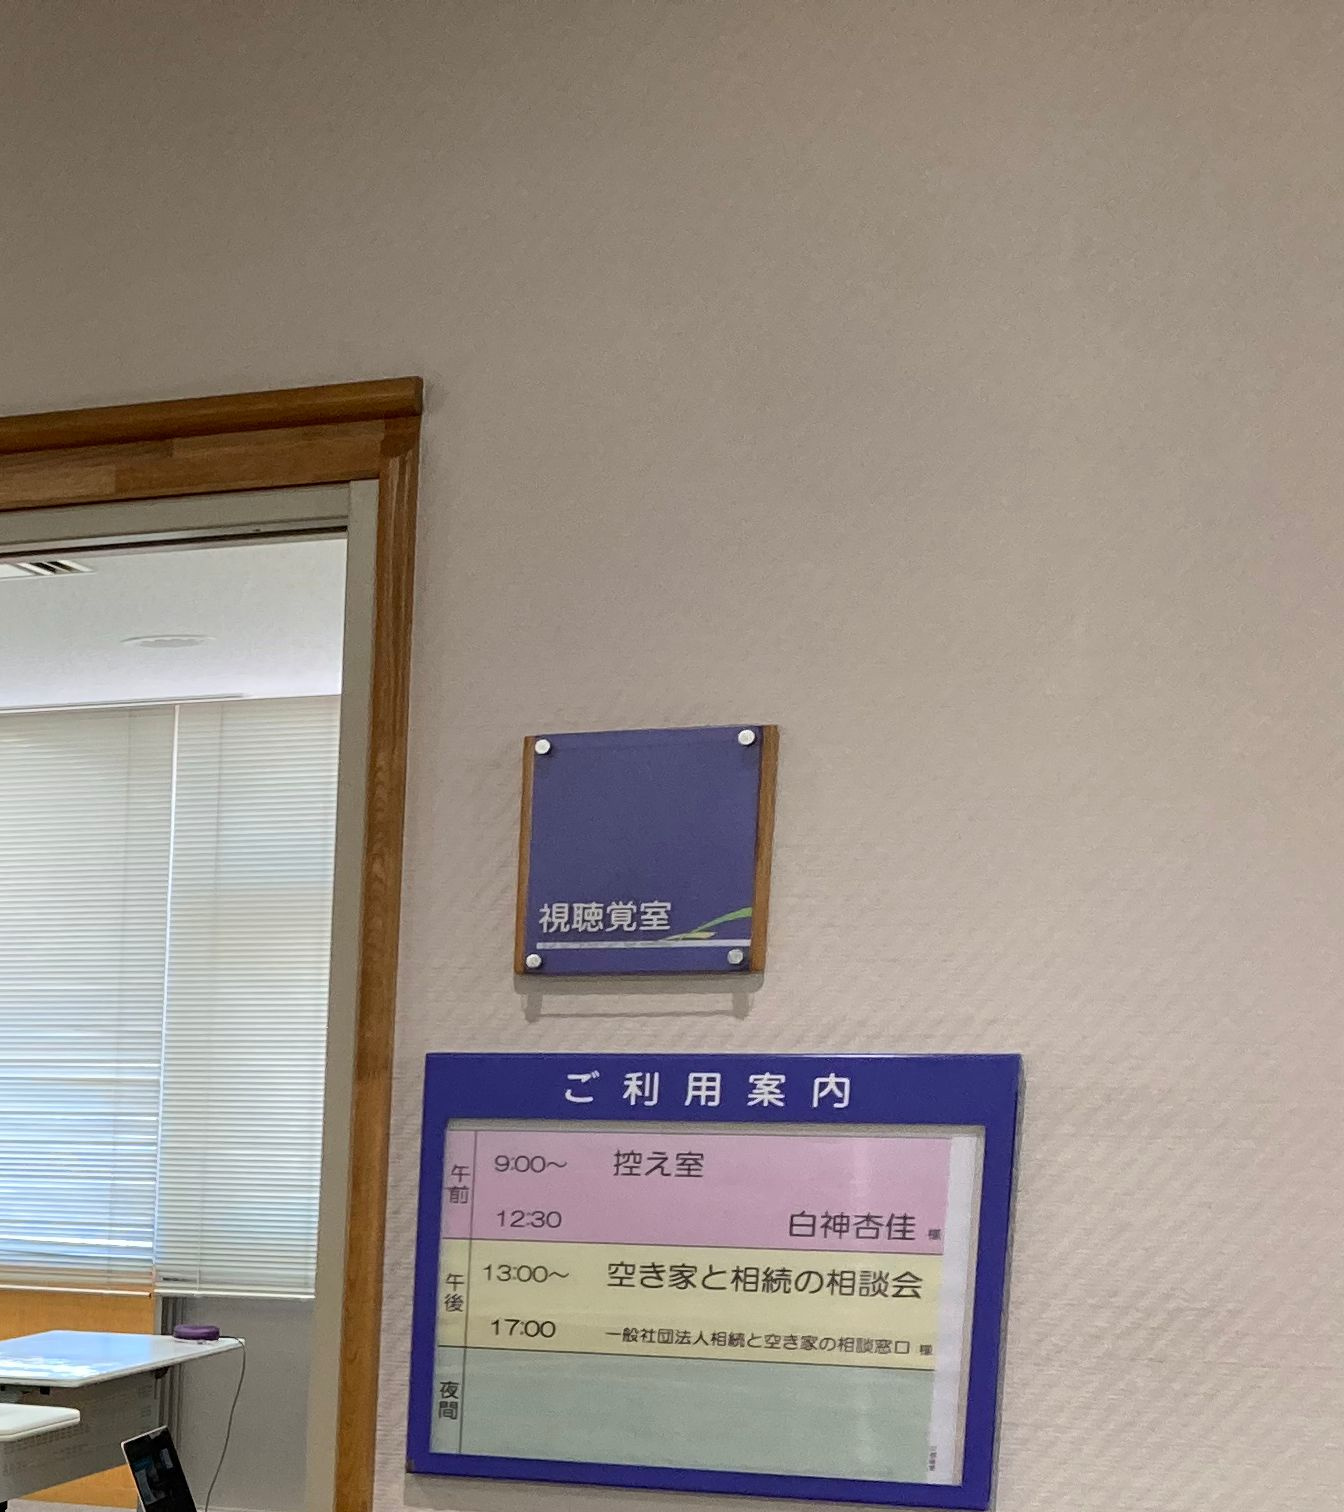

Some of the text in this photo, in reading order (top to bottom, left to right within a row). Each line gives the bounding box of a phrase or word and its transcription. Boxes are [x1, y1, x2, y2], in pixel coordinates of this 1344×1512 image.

[538, 900, 672, 933] 視聴覚室
[564, 1069, 851, 1109] ご利用案内
[613, 1149, 705, 1178] 控え室
[446, 1164, 471, 1205] 午前
[496, 1209, 942, 1241] 12:30 白神杏佳 様
[443, 1272, 465, 1313] 午後
[606, 1261, 923, 1300] 空き家と相続の相談会
[490, 1318, 934, 1356] 17:00 一般社団法人相続と空き家の相談窓口 様
[438, 1381, 460, 1421] 夜間
